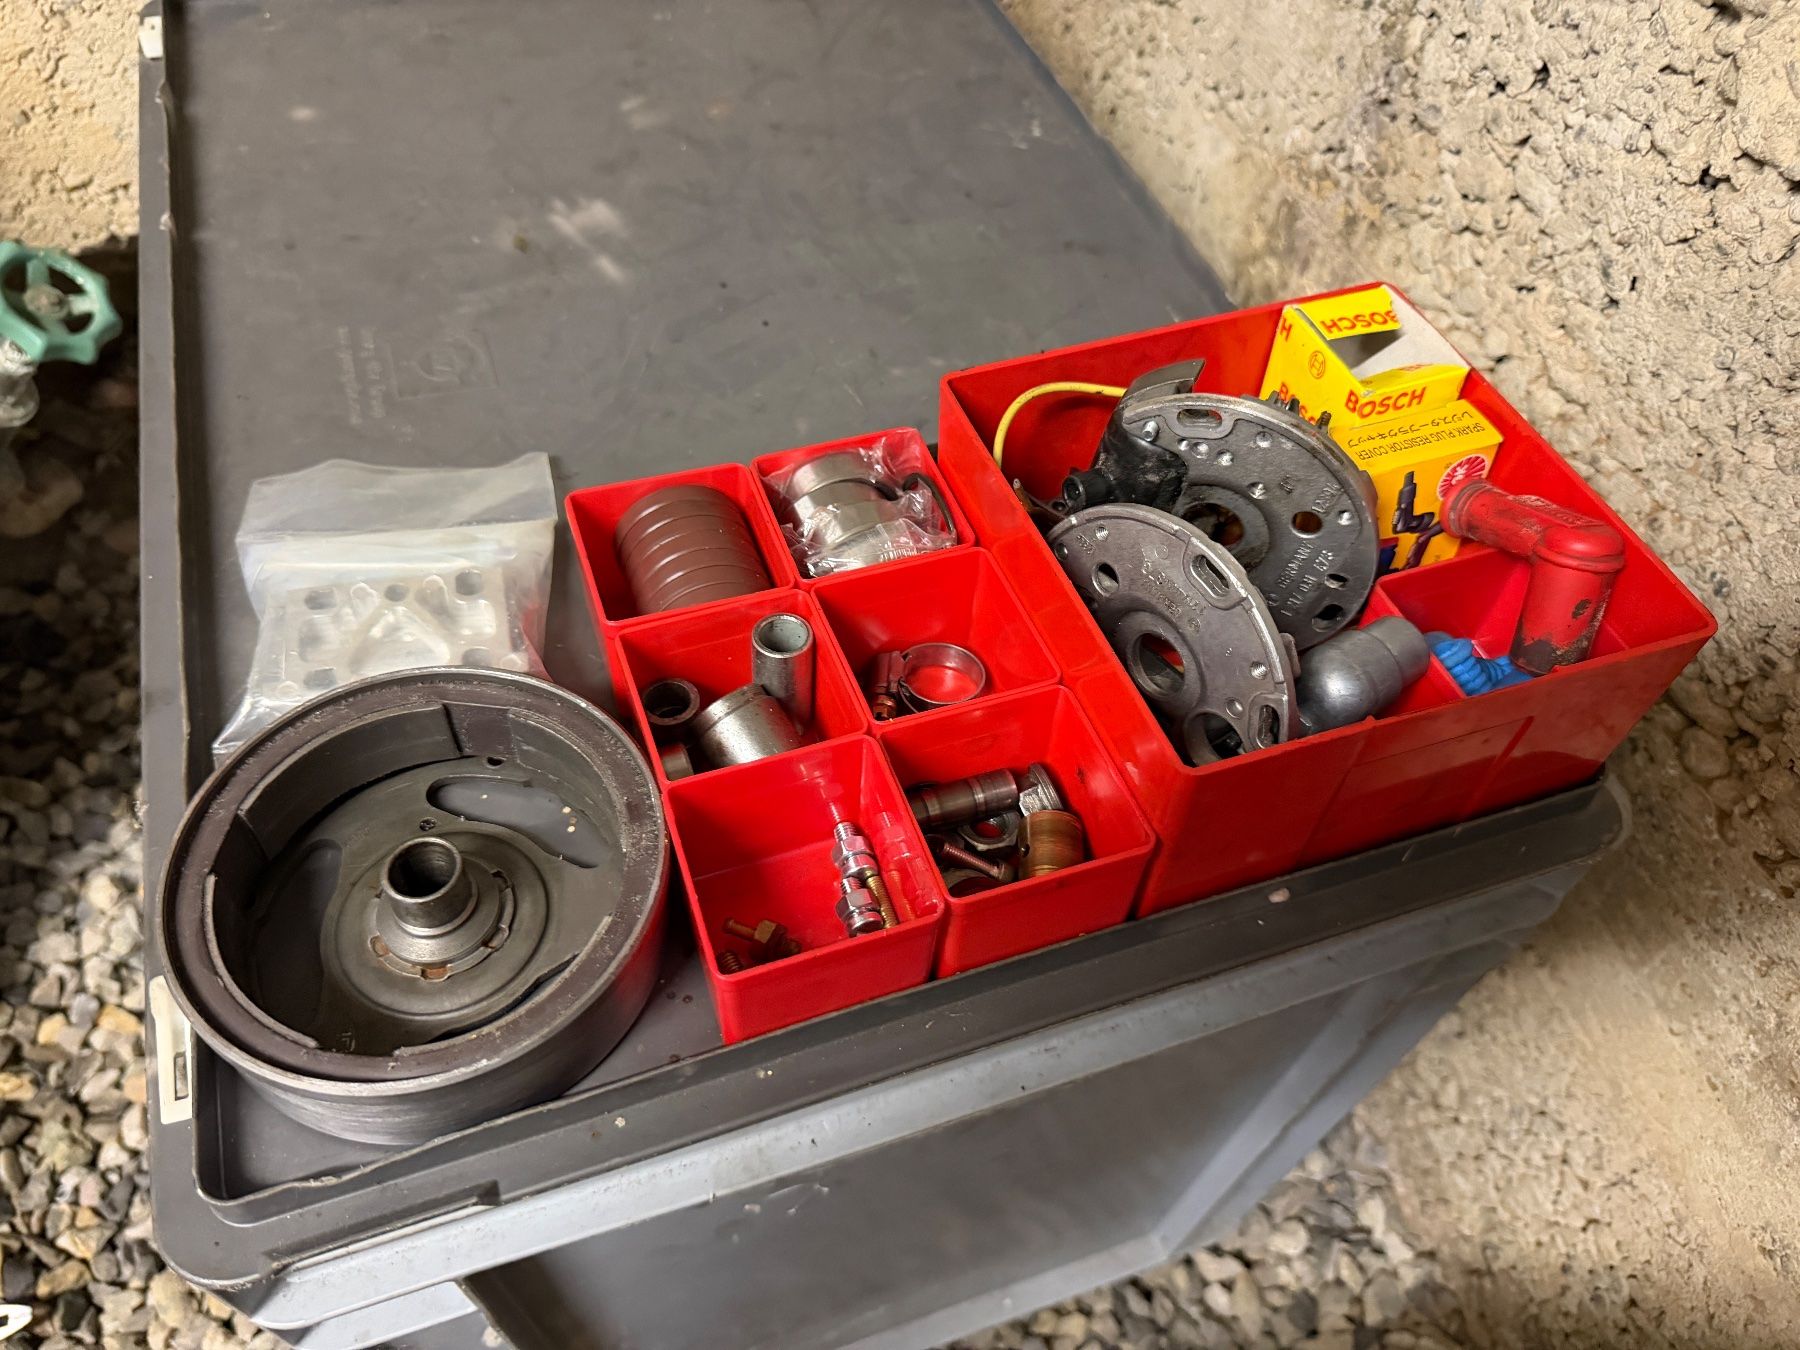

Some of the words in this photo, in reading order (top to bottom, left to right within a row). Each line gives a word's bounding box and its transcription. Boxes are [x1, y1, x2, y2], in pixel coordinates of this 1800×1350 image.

[1345, 386, 1426, 419] BOSCH
[1430, 429, 1456, 442] PLUG
[1456, 422, 1486, 437] SPARK
[1355, 444, 1389, 461] COVER
[1391, 435, 1432, 453] RESISTOR
